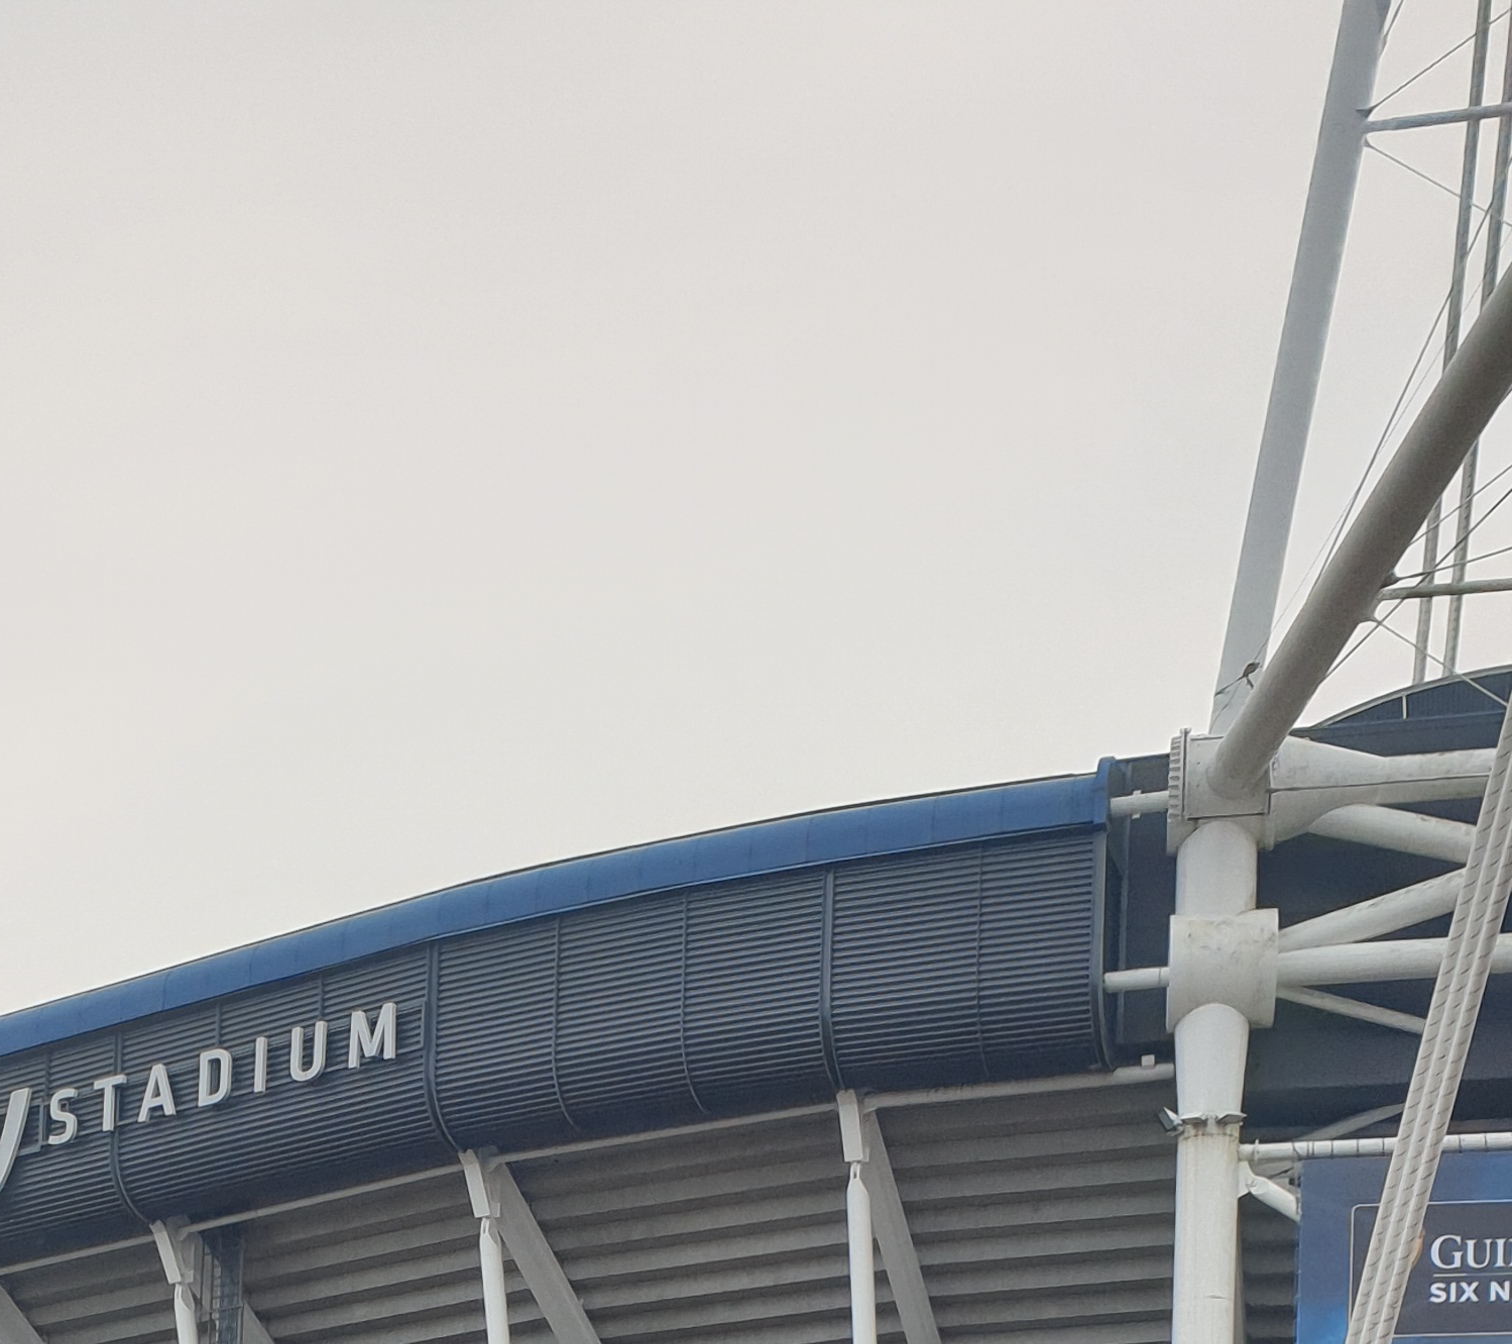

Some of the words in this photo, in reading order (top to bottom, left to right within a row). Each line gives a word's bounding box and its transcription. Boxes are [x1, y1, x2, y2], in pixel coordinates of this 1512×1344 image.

[47, 1002, 398, 1145] STADIUM
[1430, 1234, 1512, 1270] GUI
[1429, 1281, 1479, 1304] SIX
[1489, 1280, 1512, 1303] N
